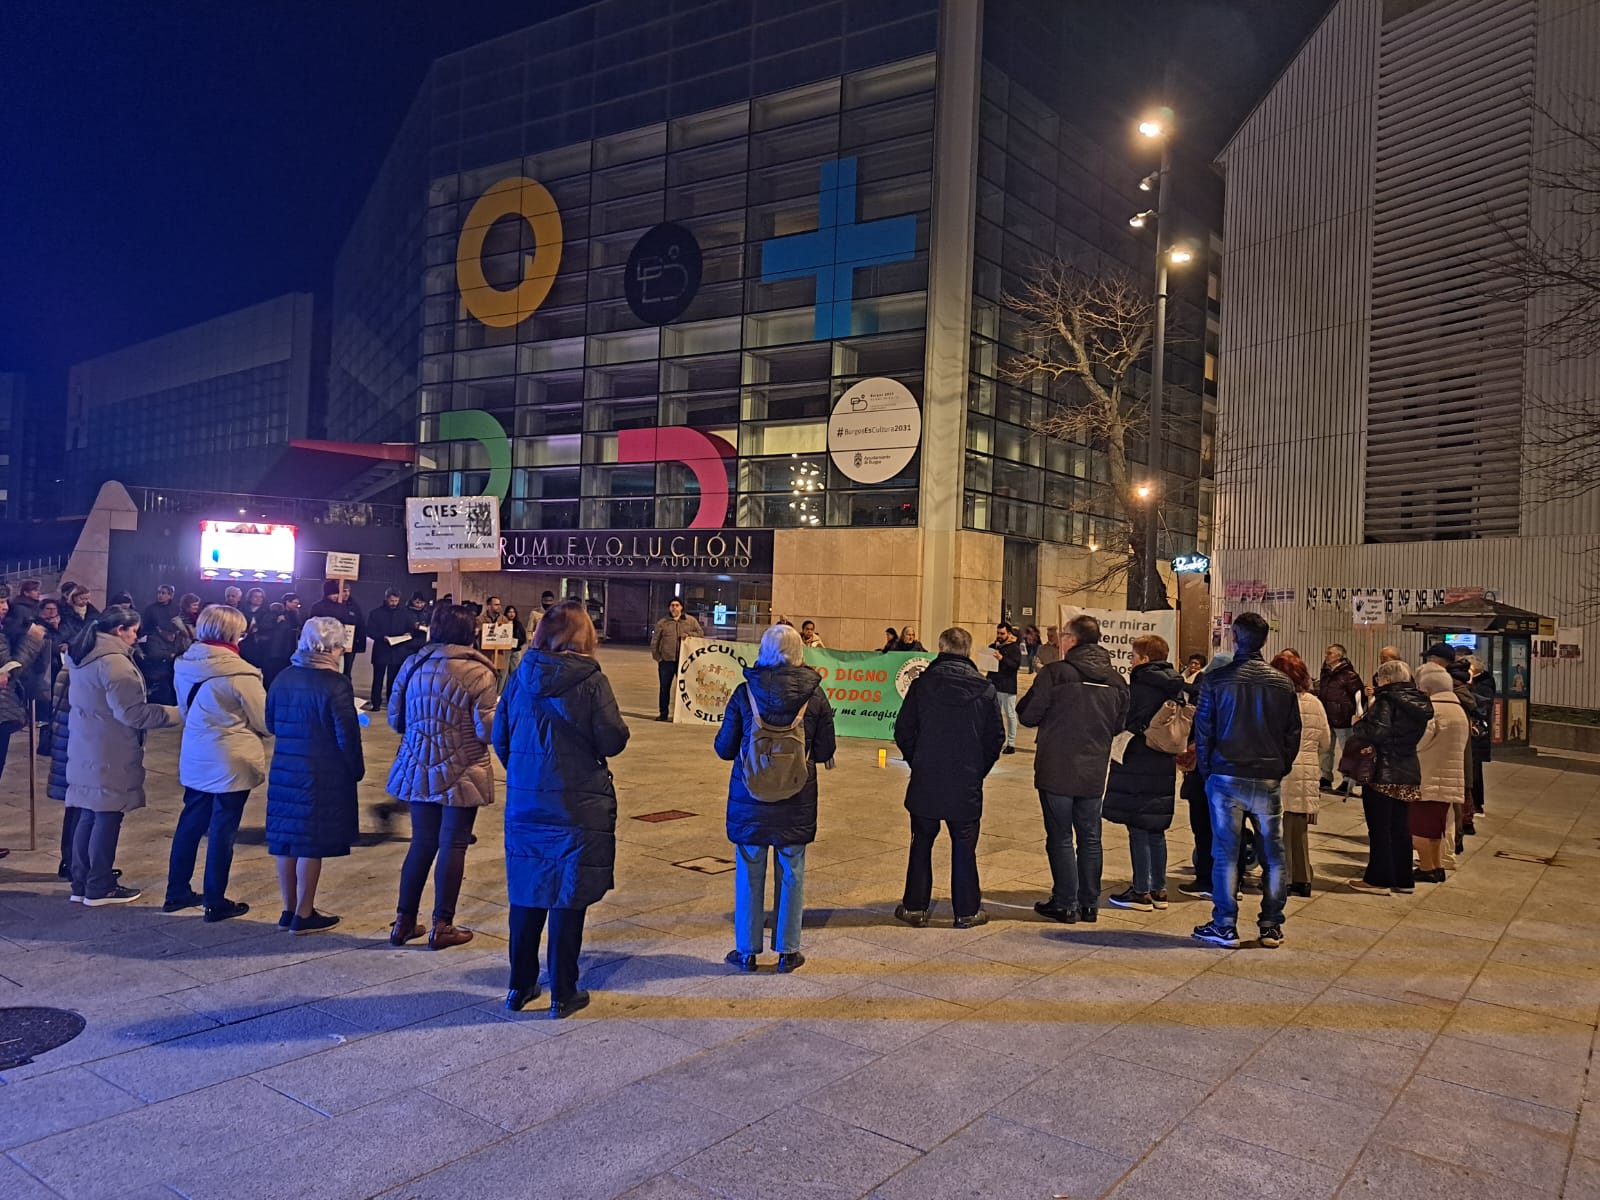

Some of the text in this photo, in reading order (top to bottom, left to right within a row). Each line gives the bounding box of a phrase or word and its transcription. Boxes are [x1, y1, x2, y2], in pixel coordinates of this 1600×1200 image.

[837, 424, 911, 438] #BurgosEsCultura2031
[422, 504, 458, 518] CIES
[567, 531, 752, 559] EVOLUCIÓN
[522, 555, 537, 566] DE
[545, 555, 633, 567] CONGRESOS
[644, 556, 650, 567] Y
[661, 555, 750, 568] AUDITORIO
[1119, 619, 1157, 631] mirar
[1540, 640, 1557, 658] DIC
[680, 644, 748, 674] CIRCULO
[835, 667, 888, 683] DIGNO
[678, 679, 692, 712] DEL
[826, 687, 882, 703] TODOS
[841, 708, 857, 716] me
